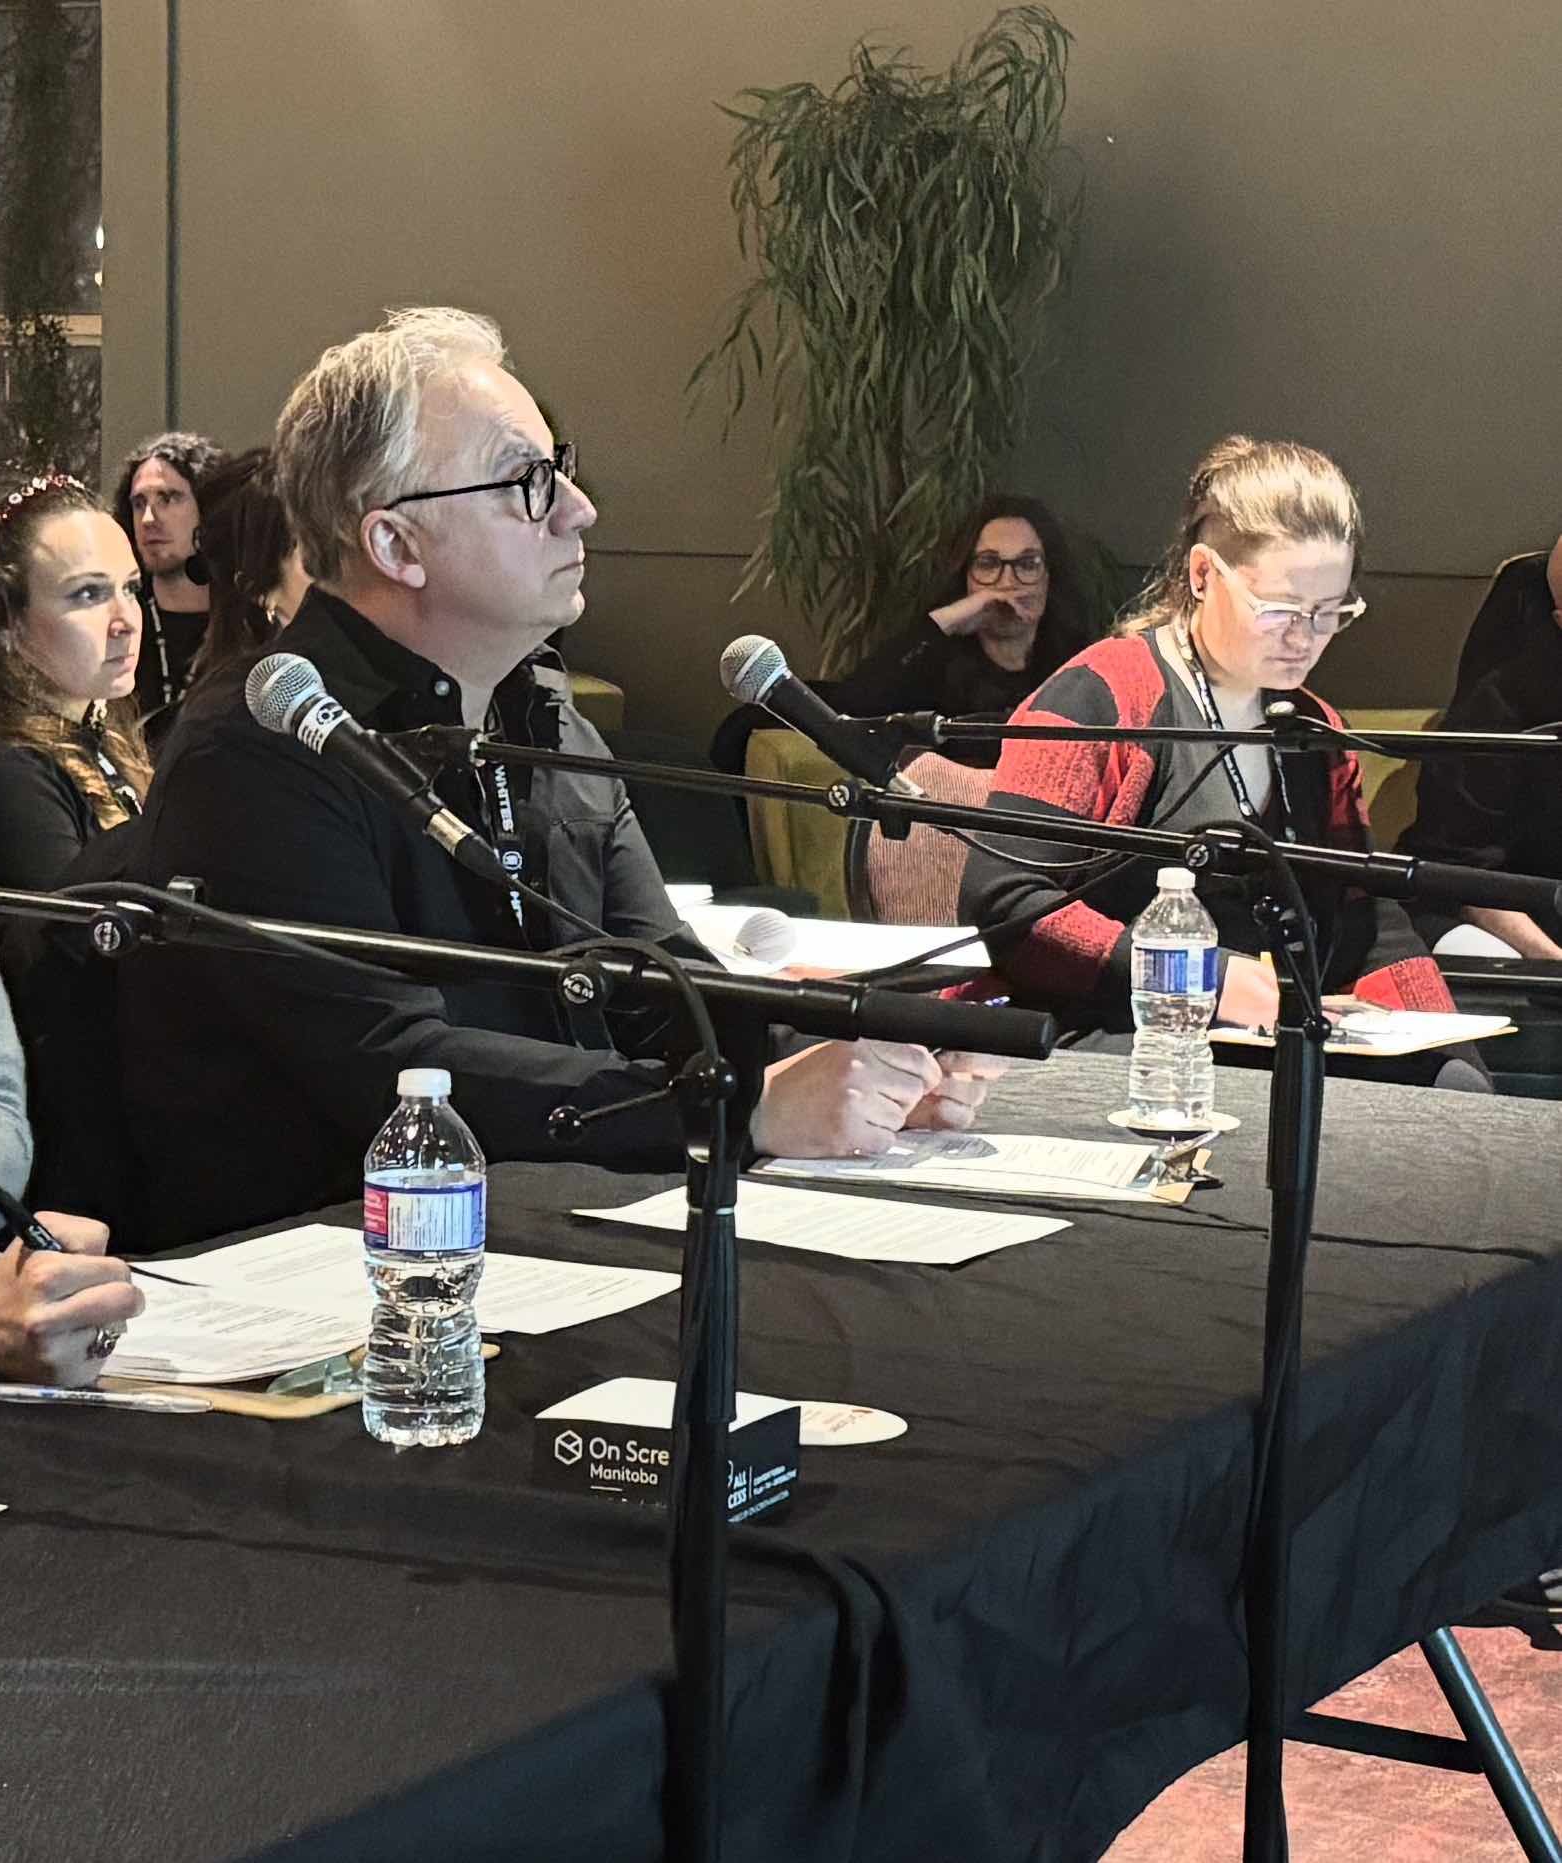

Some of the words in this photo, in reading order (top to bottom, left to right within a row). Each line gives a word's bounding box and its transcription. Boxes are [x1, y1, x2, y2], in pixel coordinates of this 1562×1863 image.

[589, 1437, 620, 1460] On
[625, 1440, 670, 1466] Scre
[590, 1462, 658, 1485] Manitoba
